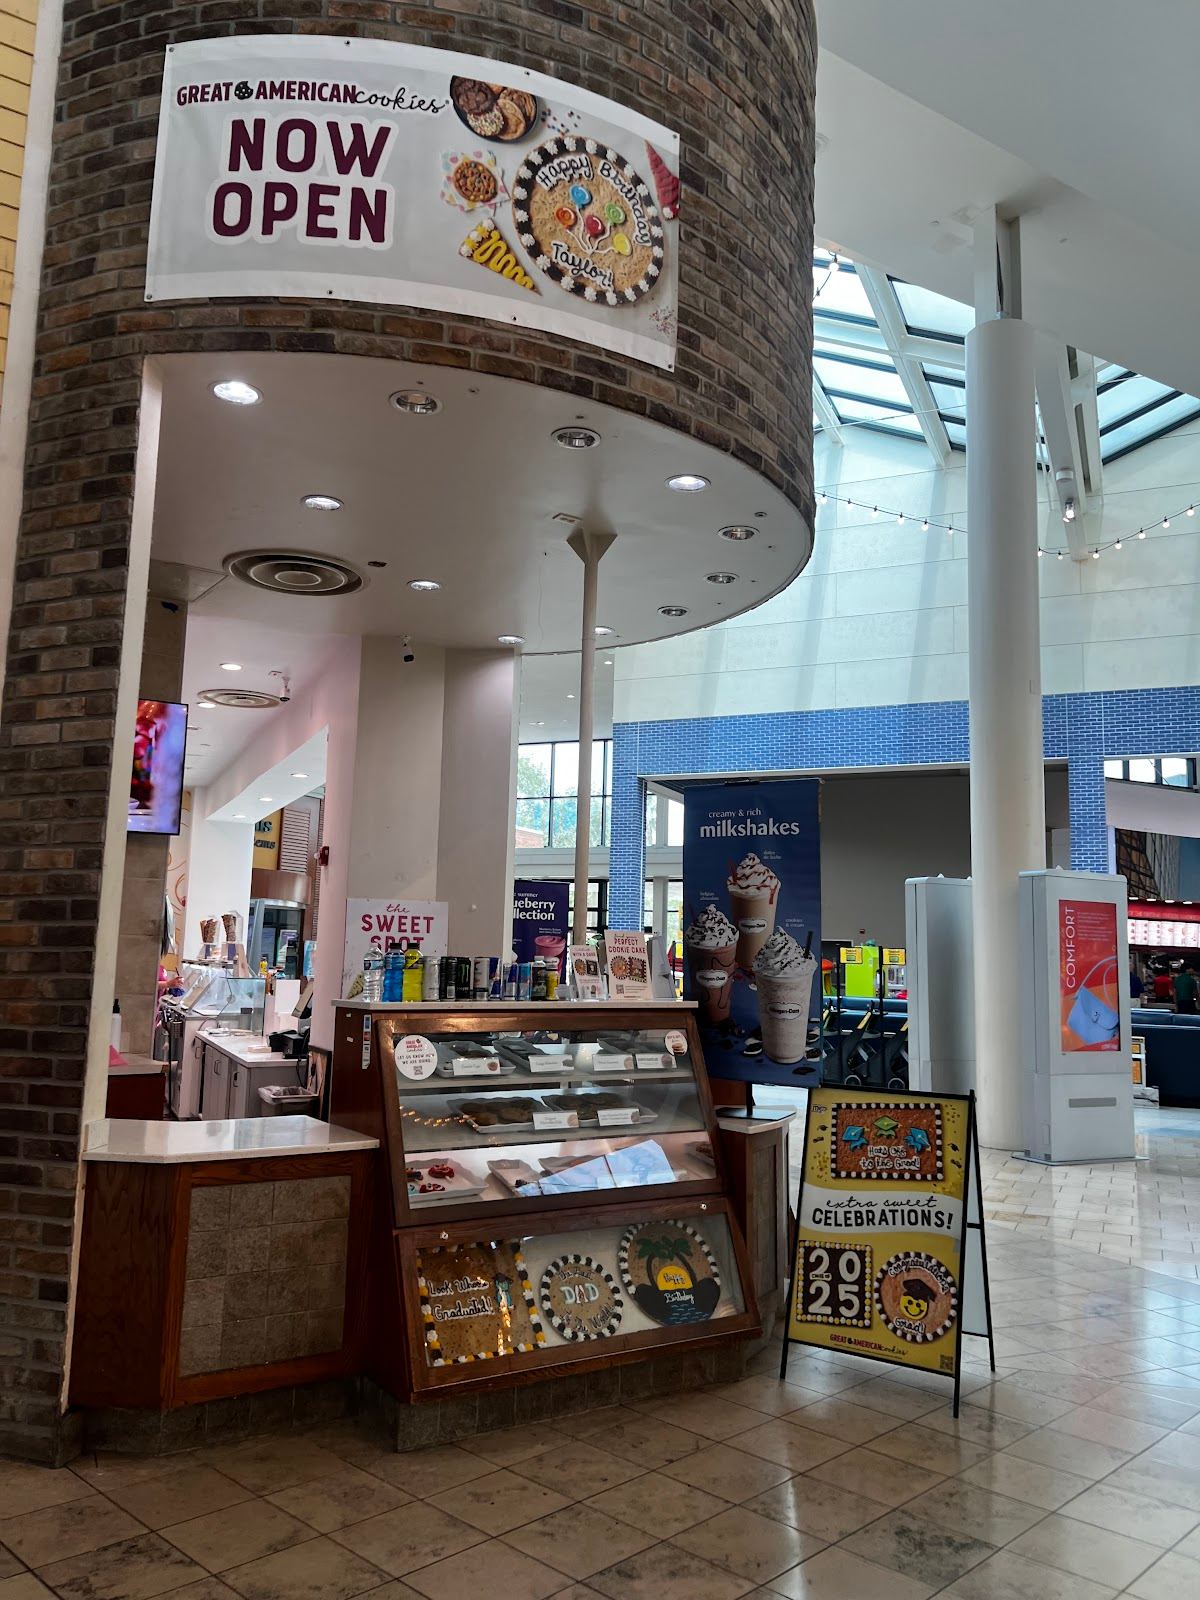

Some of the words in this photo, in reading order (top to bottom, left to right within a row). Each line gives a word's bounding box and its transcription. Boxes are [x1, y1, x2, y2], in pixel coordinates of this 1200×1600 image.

[176, 81, 233, 106] GREAT
[255, 80, 357, 103] AMERICAN
[355, 87, 446, 114] cookies
[228, 118, 392, 178] NOW
[537, 154, 592, 188] Happy
[599, 161, 651, 246] Birthday
[213, 181, 388, 243] OPEN
[552, 243, 613, 288] Taylor!
[708, 809, 736, 818] creamy
[738, 808, 745, 817] &
[746, 807, 762, 817] rich
[700, 817, 800, 838] milkshakes
[386, 903, 410, 913] the
[361, 913, 434, 934] SWEET
[608, 945, 630, 954] COOKIE
[631, 946, 646, 954] CAKE
[614, 937, 639, 946] PERFECT
[1064, 906, 1076, 989] COMFORT
[860, 1157, 874, 1169] to
[826, 1195, 878, 1208] extra
[884, 1195, 937, 1208] sweet
[812, 1207, 954, 1230] CELEBRATIONS!
[808, 1247, 862, 1283] 20
[428, 1280, 454, 1296] Look
[560, 1283, 599, 1304] DAD
[664, 1290, 695, 1304] Birthday
[433, 1295, 495, 1321] Graduated!
[808, 1280, 860, 1318] 25
